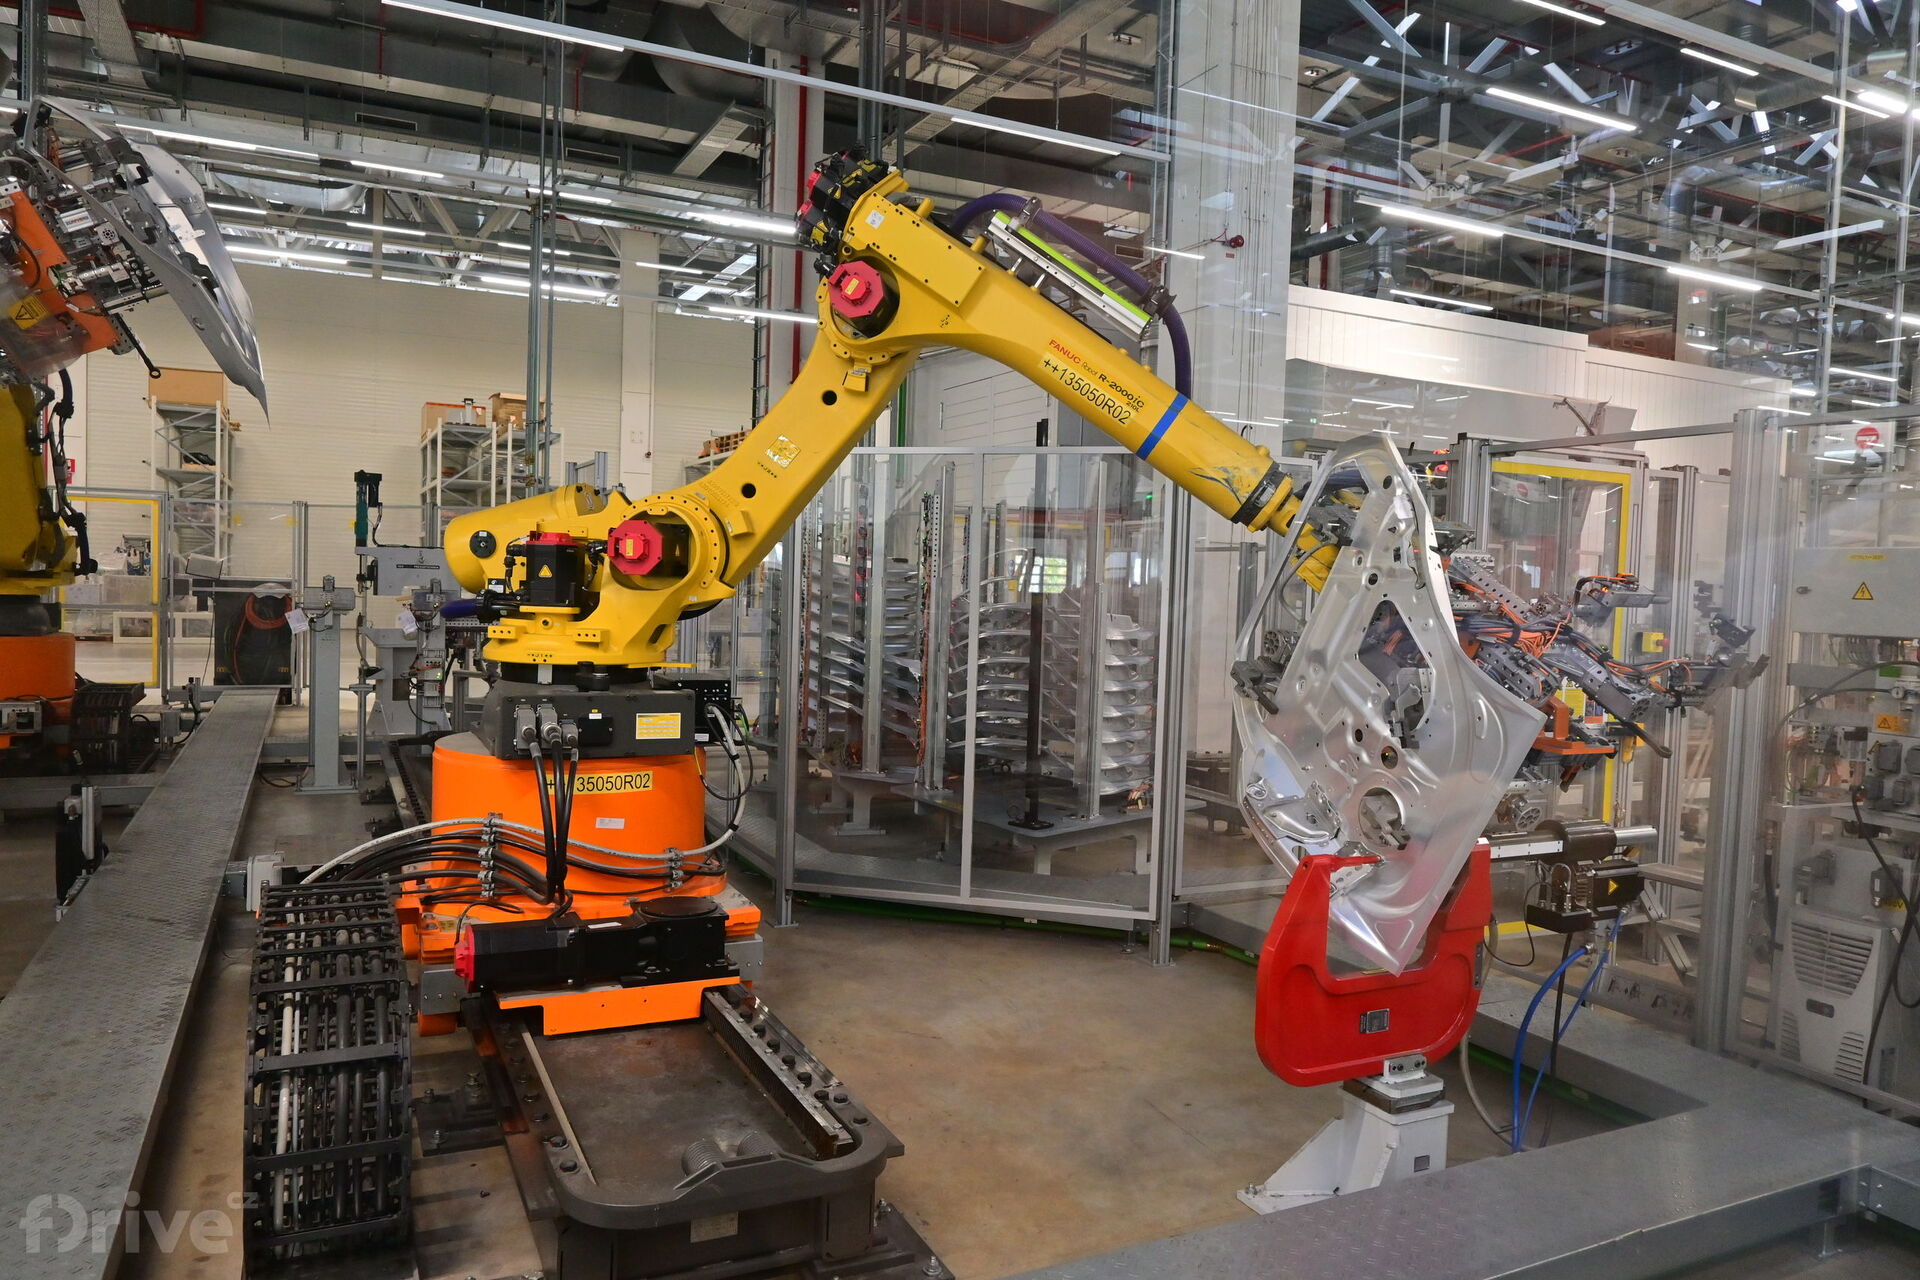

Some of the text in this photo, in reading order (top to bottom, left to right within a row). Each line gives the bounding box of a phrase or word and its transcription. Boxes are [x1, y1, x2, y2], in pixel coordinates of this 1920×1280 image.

[1048, 339, 1081, 365] FANUC
[1043, 358, 1131, 425] ++135050R02
[546, 773, 651, 792] +35050R02
